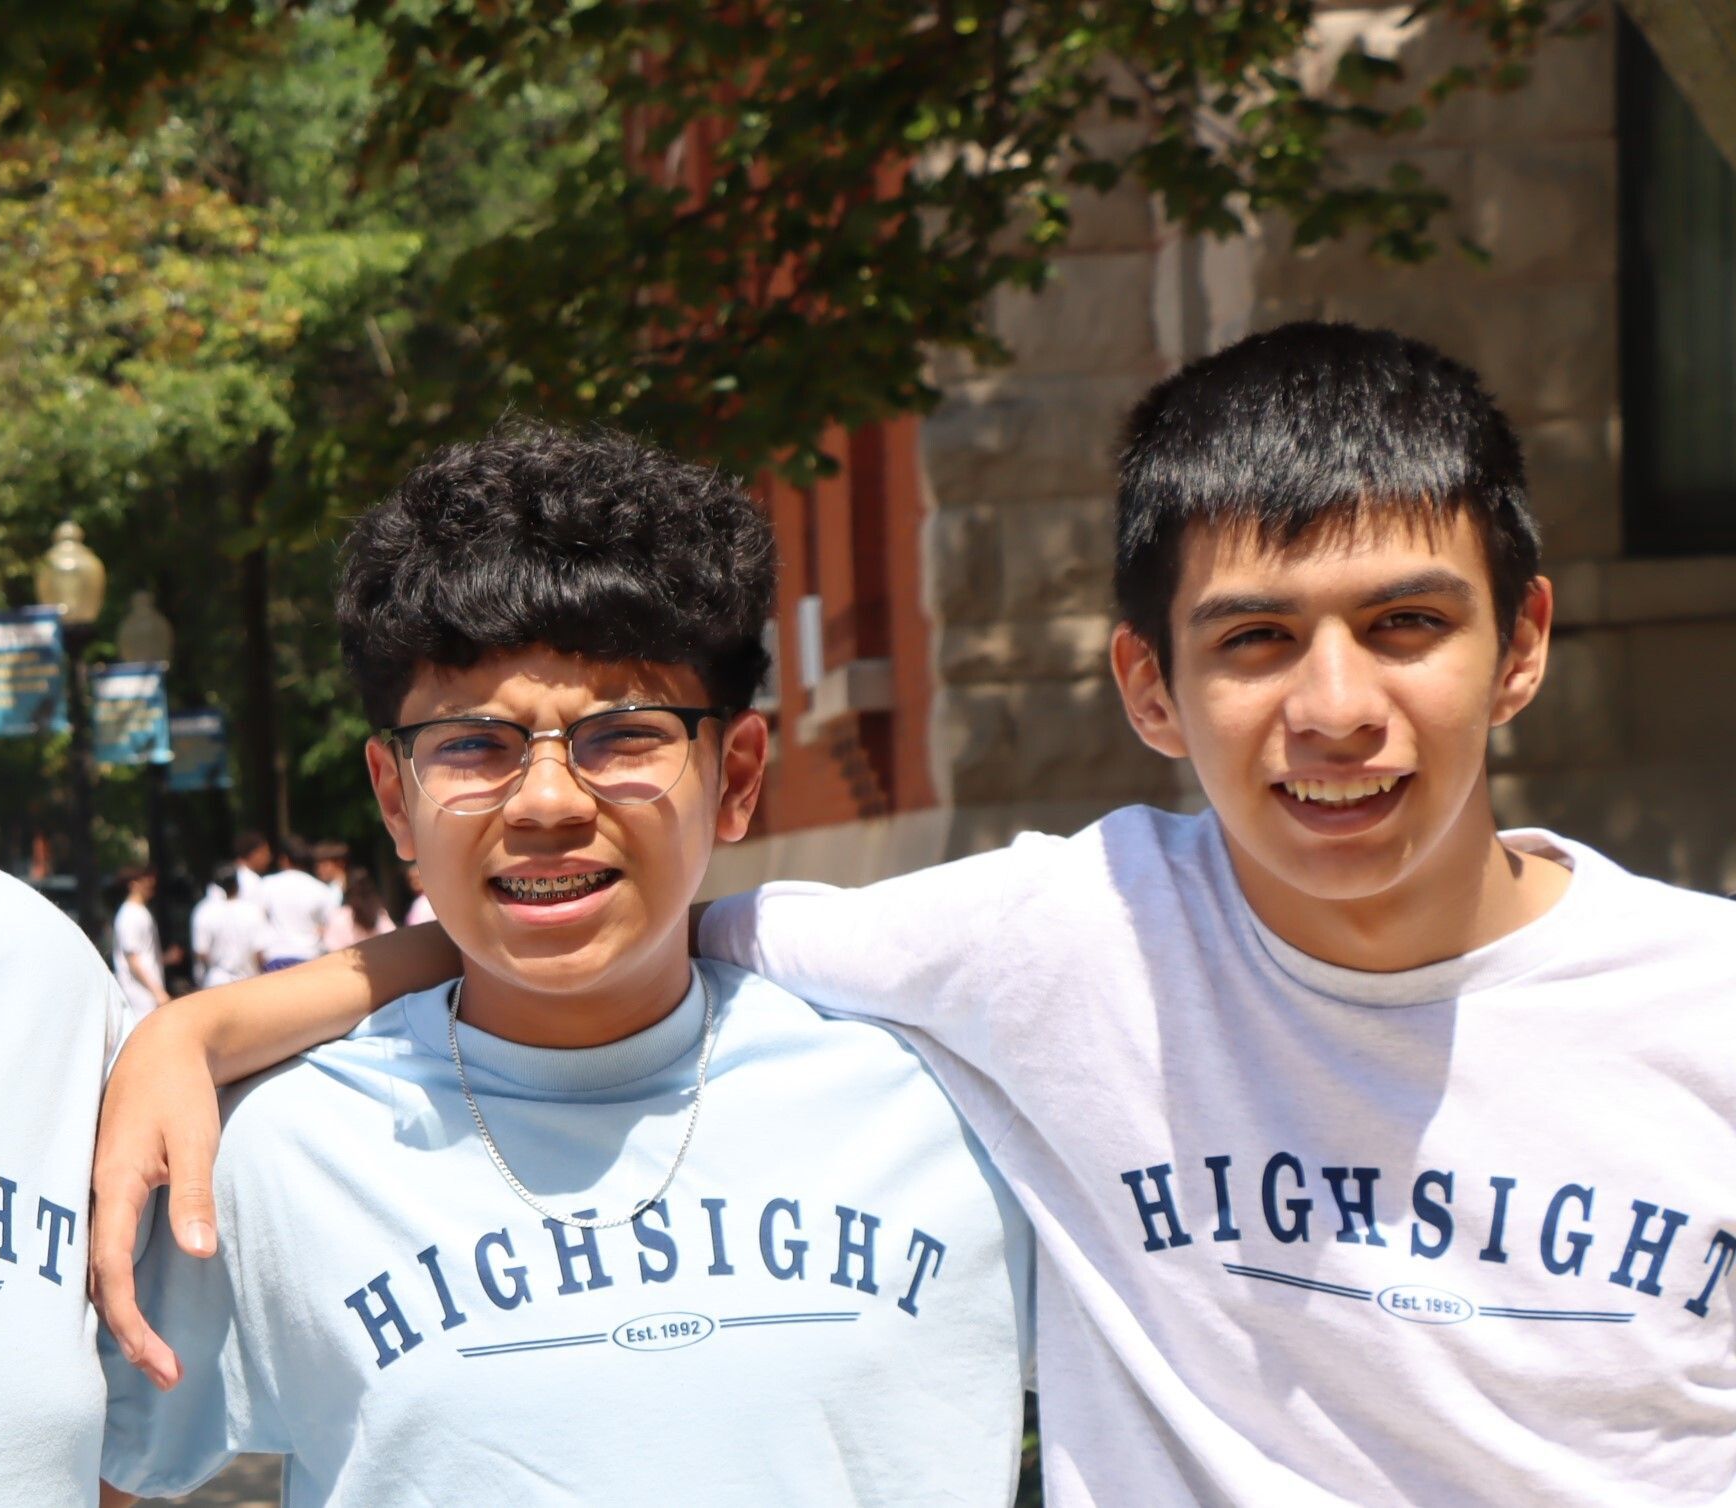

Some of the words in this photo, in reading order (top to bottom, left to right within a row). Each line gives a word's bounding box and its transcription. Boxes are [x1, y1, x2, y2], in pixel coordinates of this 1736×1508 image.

[1121, 1151, 1736, 1319] HIGHSIGHT
[345, 1197, 948, 1370] HIGHSIGHT
[626, 1326, 658, 1342] Est.
[660, 1320, 701, 1338] 1992
[1426, 1297, 1461, 1315] 1992
